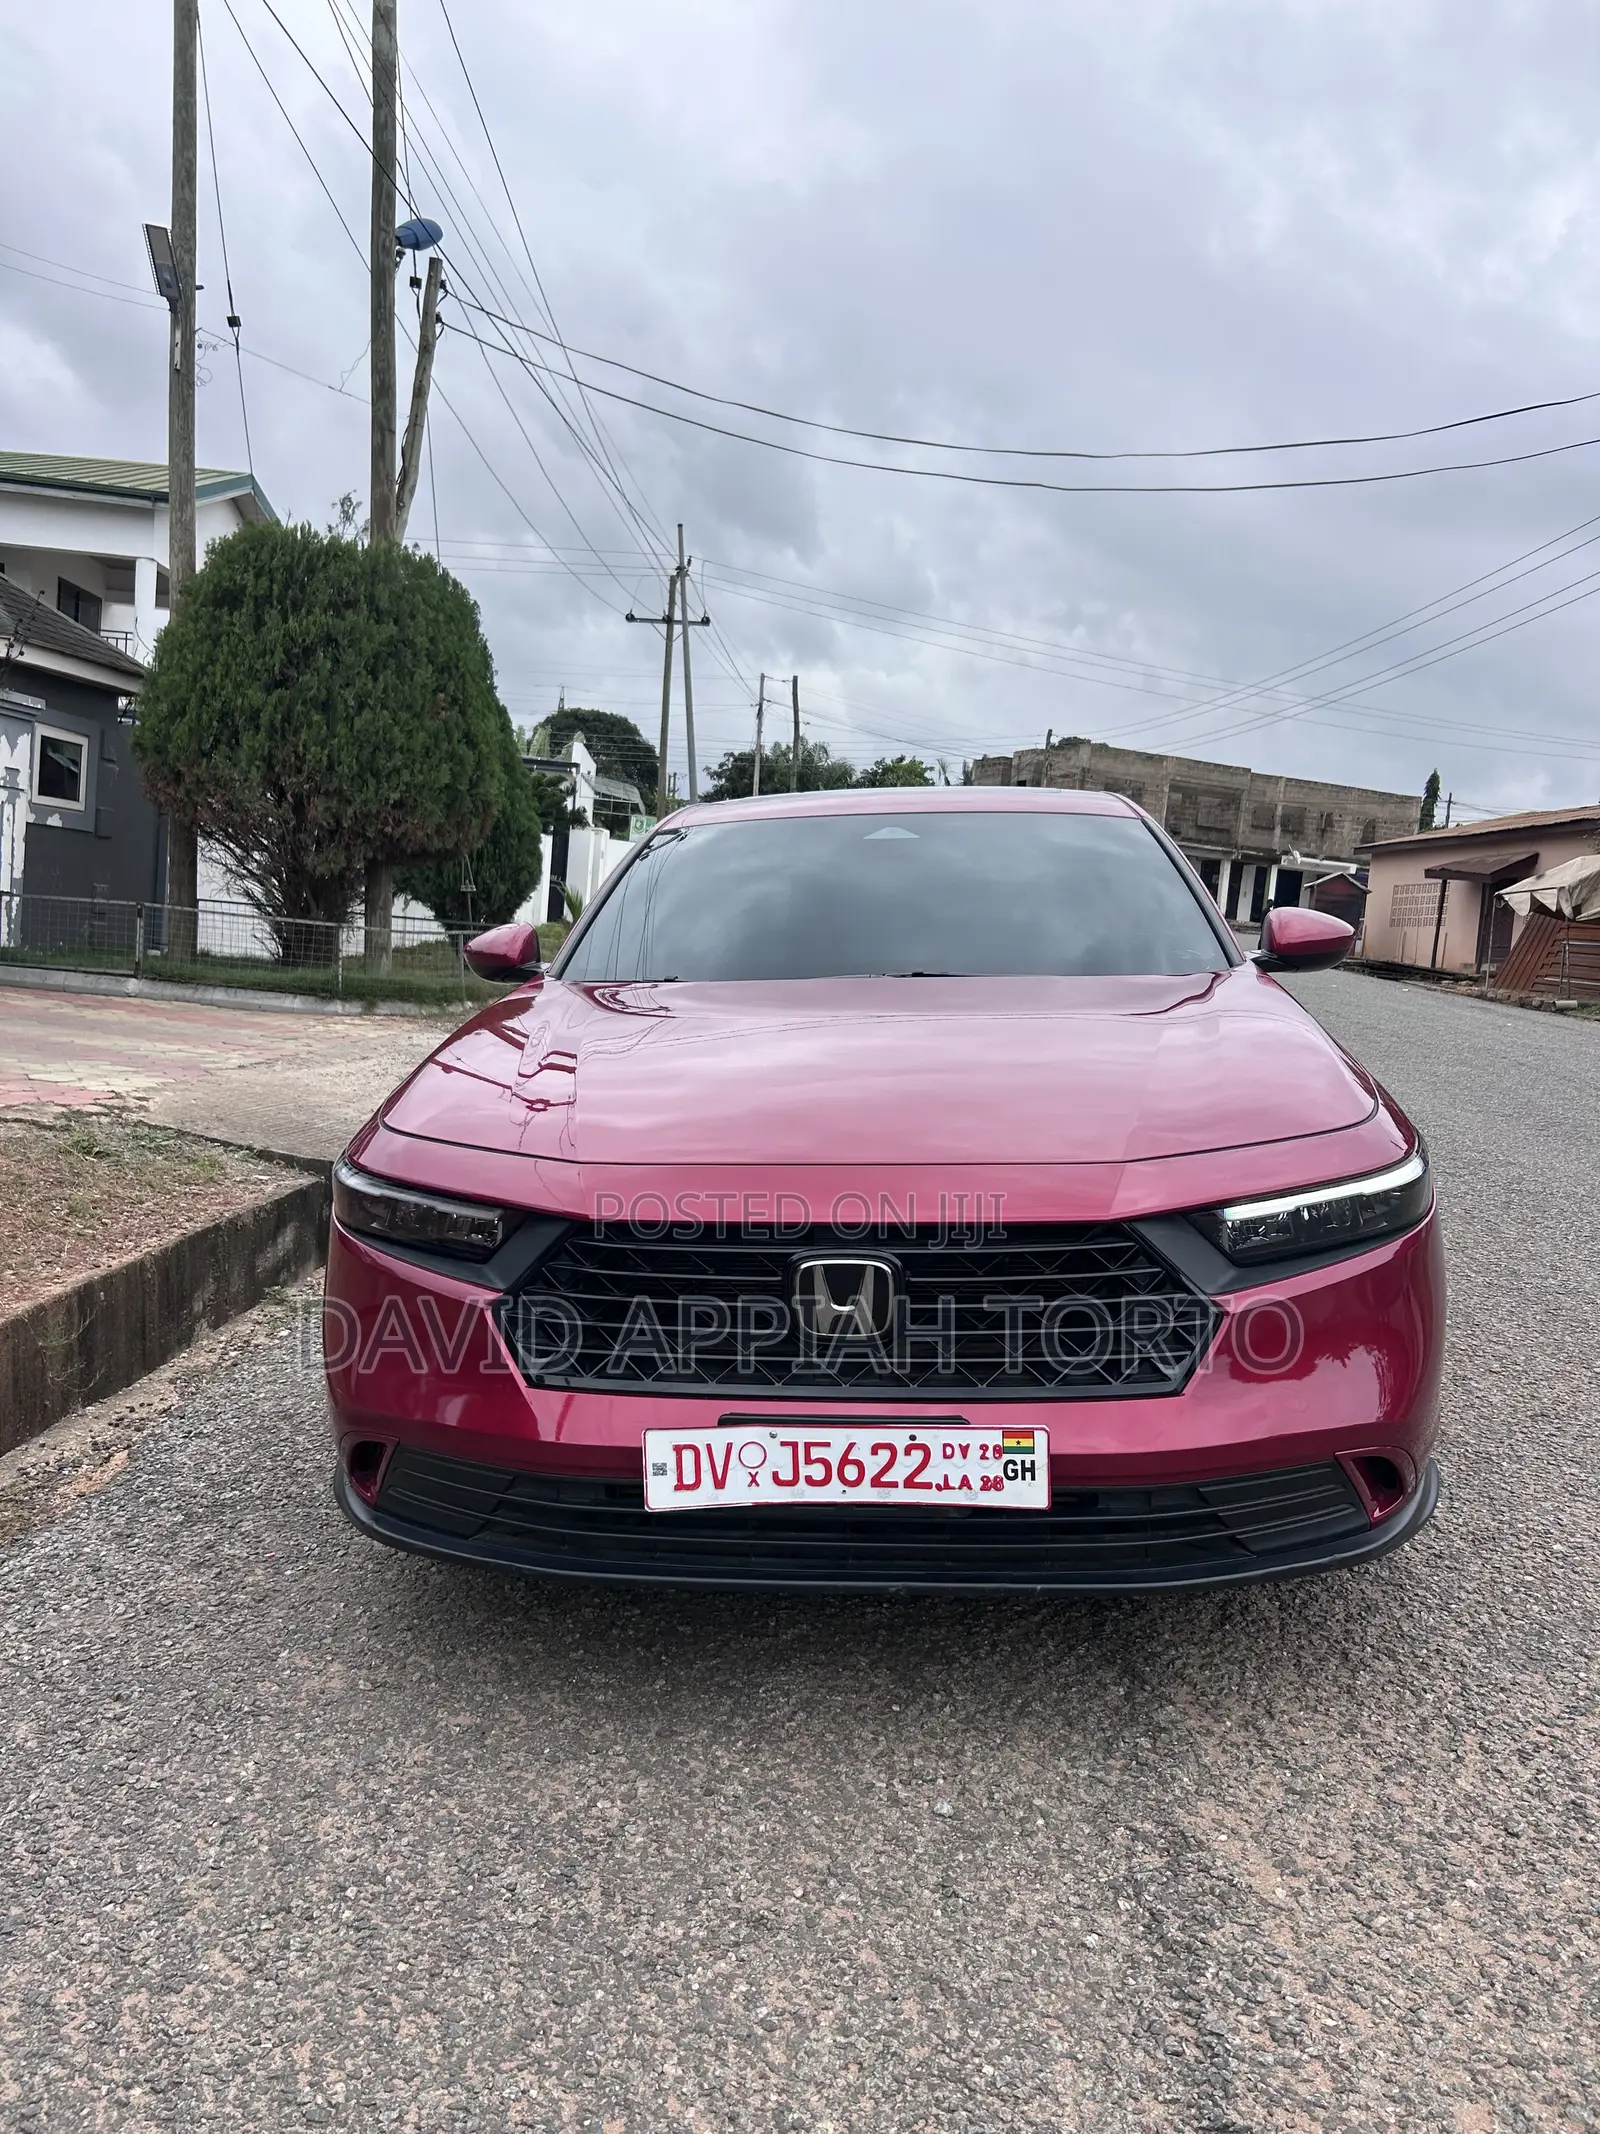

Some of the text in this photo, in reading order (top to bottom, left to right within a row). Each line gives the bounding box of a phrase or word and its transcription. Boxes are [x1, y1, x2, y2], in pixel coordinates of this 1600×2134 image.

[942, 1442, 971, 1460] DV
[672, 1441, 934, 1492] DV J5622
[1003, 1459, 1036, 1481] GH
